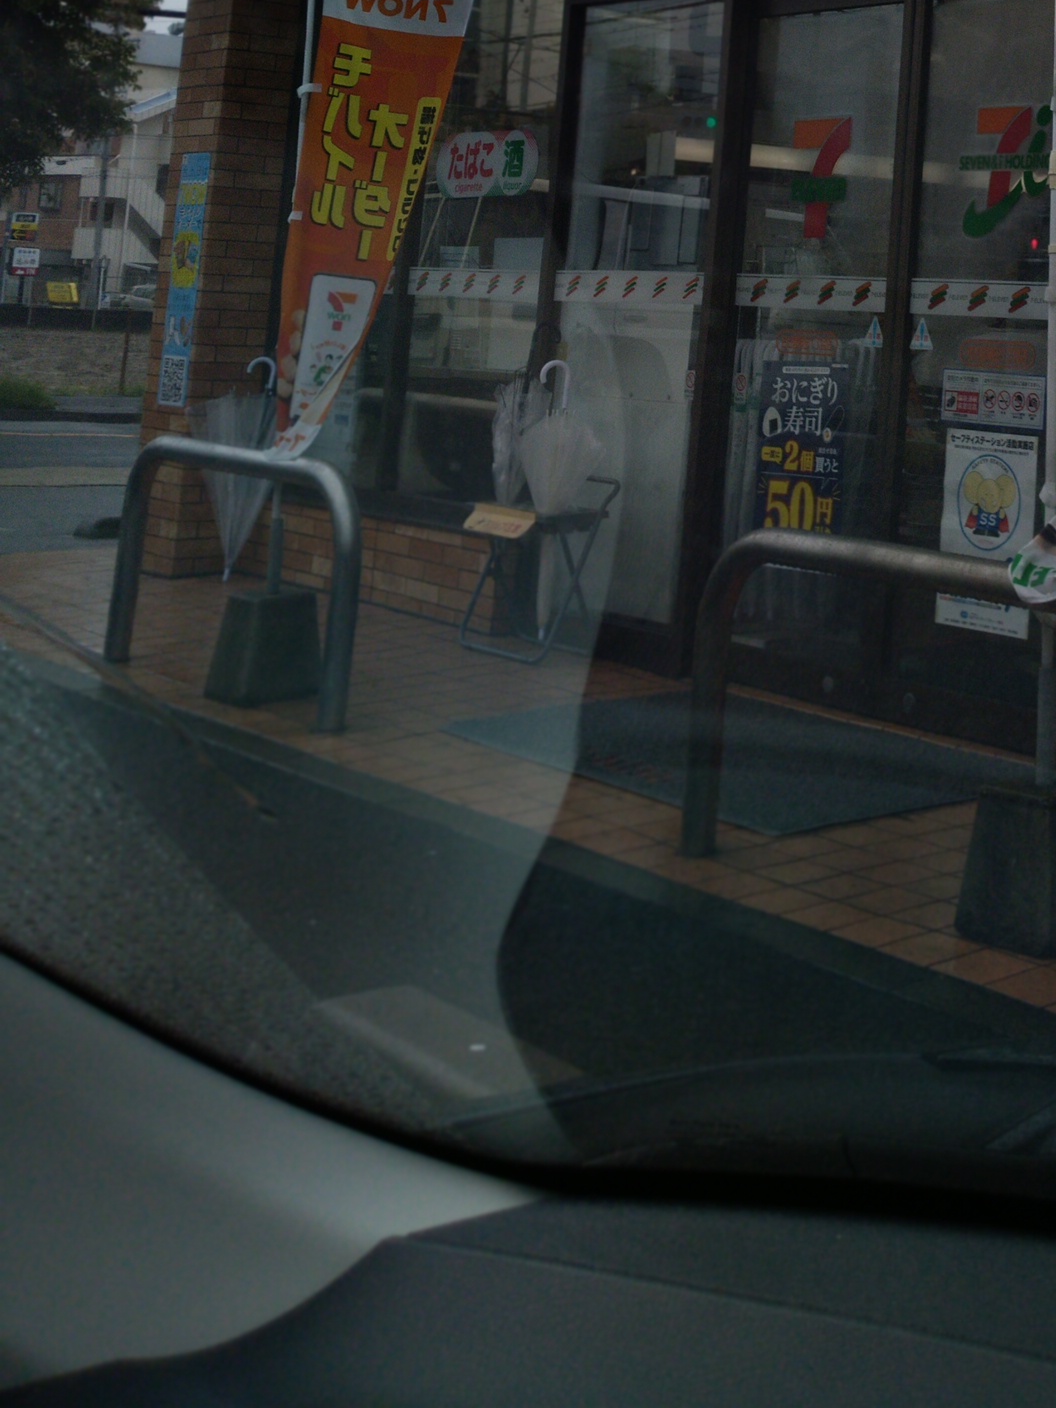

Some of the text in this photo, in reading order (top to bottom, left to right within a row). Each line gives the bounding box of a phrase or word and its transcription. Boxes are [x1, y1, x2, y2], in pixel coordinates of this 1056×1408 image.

[447, 140, 525, 180] たばこ 酒
[771, 377, 840, 405] おにぎり
[783, 405, 824, 438] 寿司
[979, 512, 998, 527] SS
